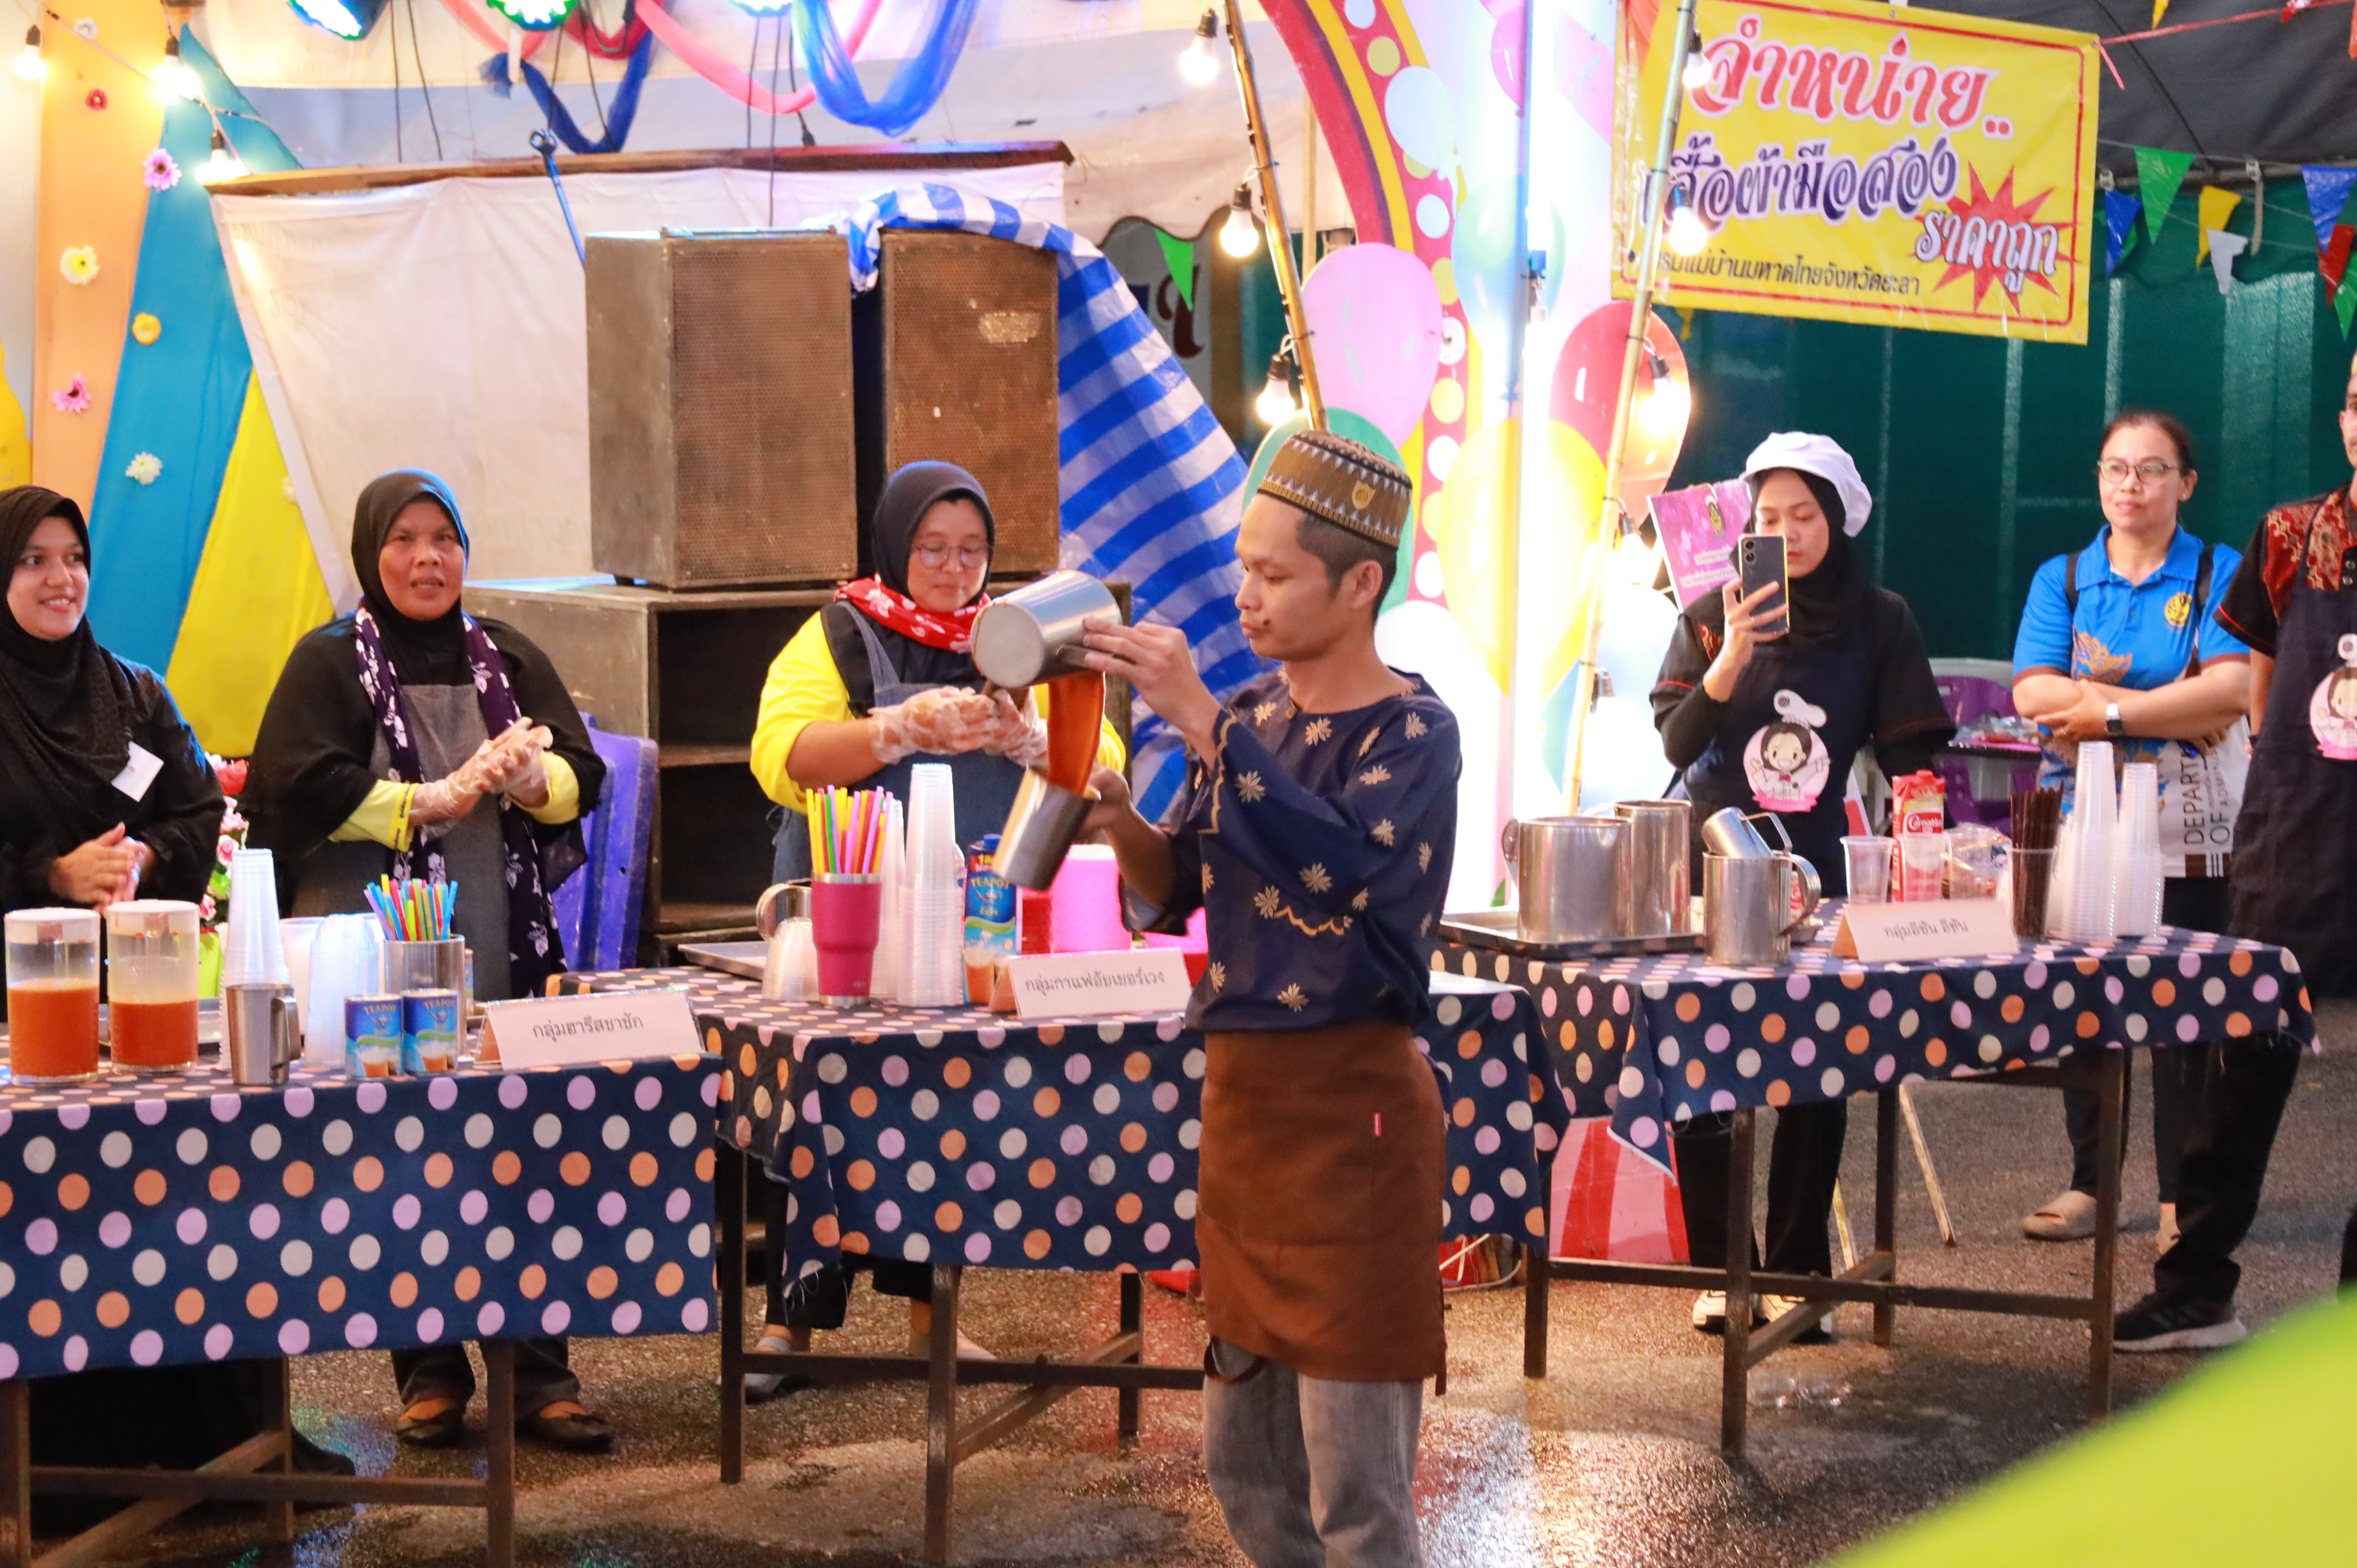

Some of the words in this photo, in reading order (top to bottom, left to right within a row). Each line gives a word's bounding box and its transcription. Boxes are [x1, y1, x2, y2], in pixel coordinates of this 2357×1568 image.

[1915, 212, 2059, 294] ราคาถูก
[2210, 812, 2230, 844] OF
[970, 877, 1010, 889] TEAPOT
